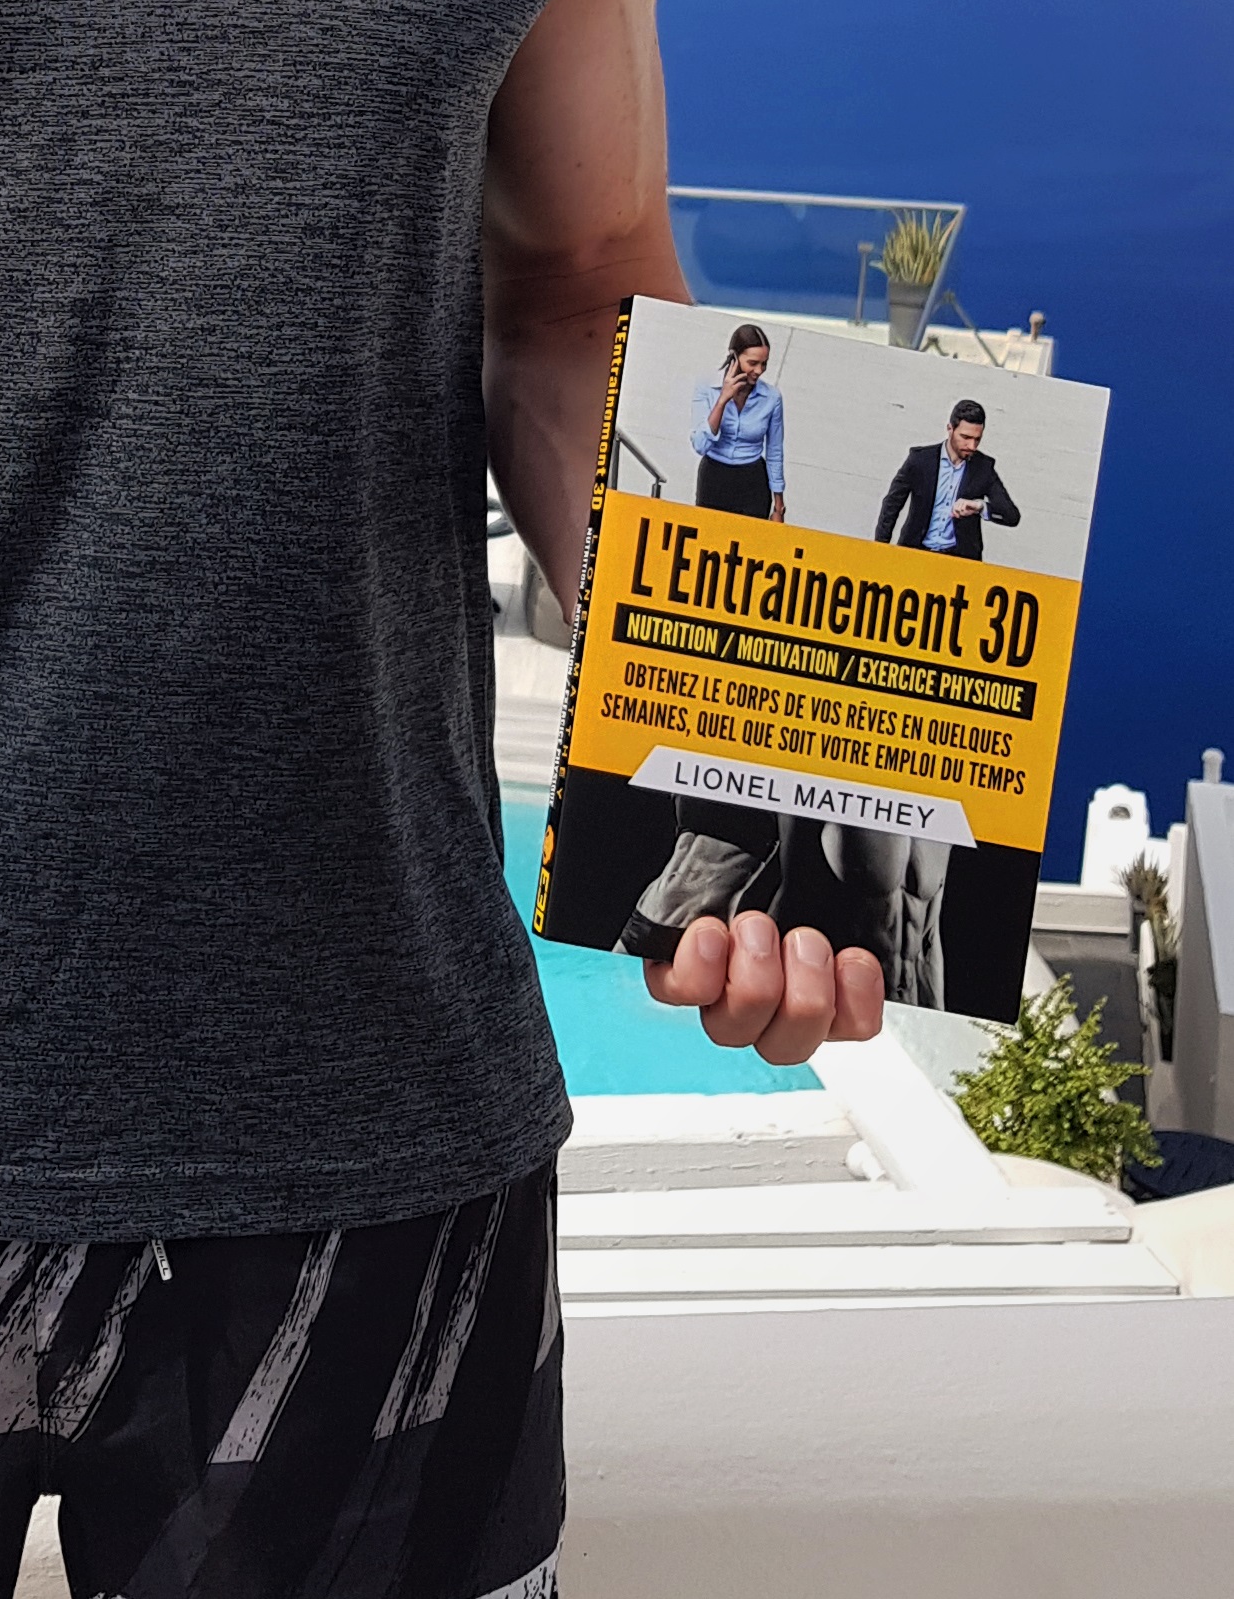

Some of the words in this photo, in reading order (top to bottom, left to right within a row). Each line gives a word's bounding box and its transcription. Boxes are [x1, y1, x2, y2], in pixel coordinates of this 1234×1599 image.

[591, 483, 605, 510] 3D
[578, 534, 598, 638] LIONEL
[630, 517, 969, 657] L'Entrainement
[979, 585, 1039, 668] 3D
[624, 661, 699, 699] OBTENEZ
[702, 676, 722, 703] LE
[725, 681, 780, 714] CORPS
[784, 692, 806, 719] DE
[811, 696, 842, 726] VOS
[845, 701, 897, 736] RÊVES
[901, 714, 924, 741] EN
[927, 719, 1013, 757] QUELQUES
[626, 613, 717, 657] NUTRITION
[720, 631, 735, 658] /
[736, 635, 839, 678] MOTIVATION
[841, 655, 855, 681] /
[857, 657, 936, 697] EXERCICE
[939, 673, 1024, 713] PHYSIQUE
[556, 662, 580, 800] MATTHEY
[601, 693, 690, 737] SEMAINES,
[696, 711, 737, 742] QUEL
[742, 719, 775, 748] QUE
[778, 726, 816, 755] SOIT
[821, 733, 872, 767] VOTRE
[874, 745, 936, 778] EMPLOI
[940, 757, 964, 783] DU
[969, 761, 1026, 795] TEMPS
[674, 762, 781, 802] LIONEL
[794, 784, 935, 829] MATTHEY
[533, 866, 550, 933] E3D
